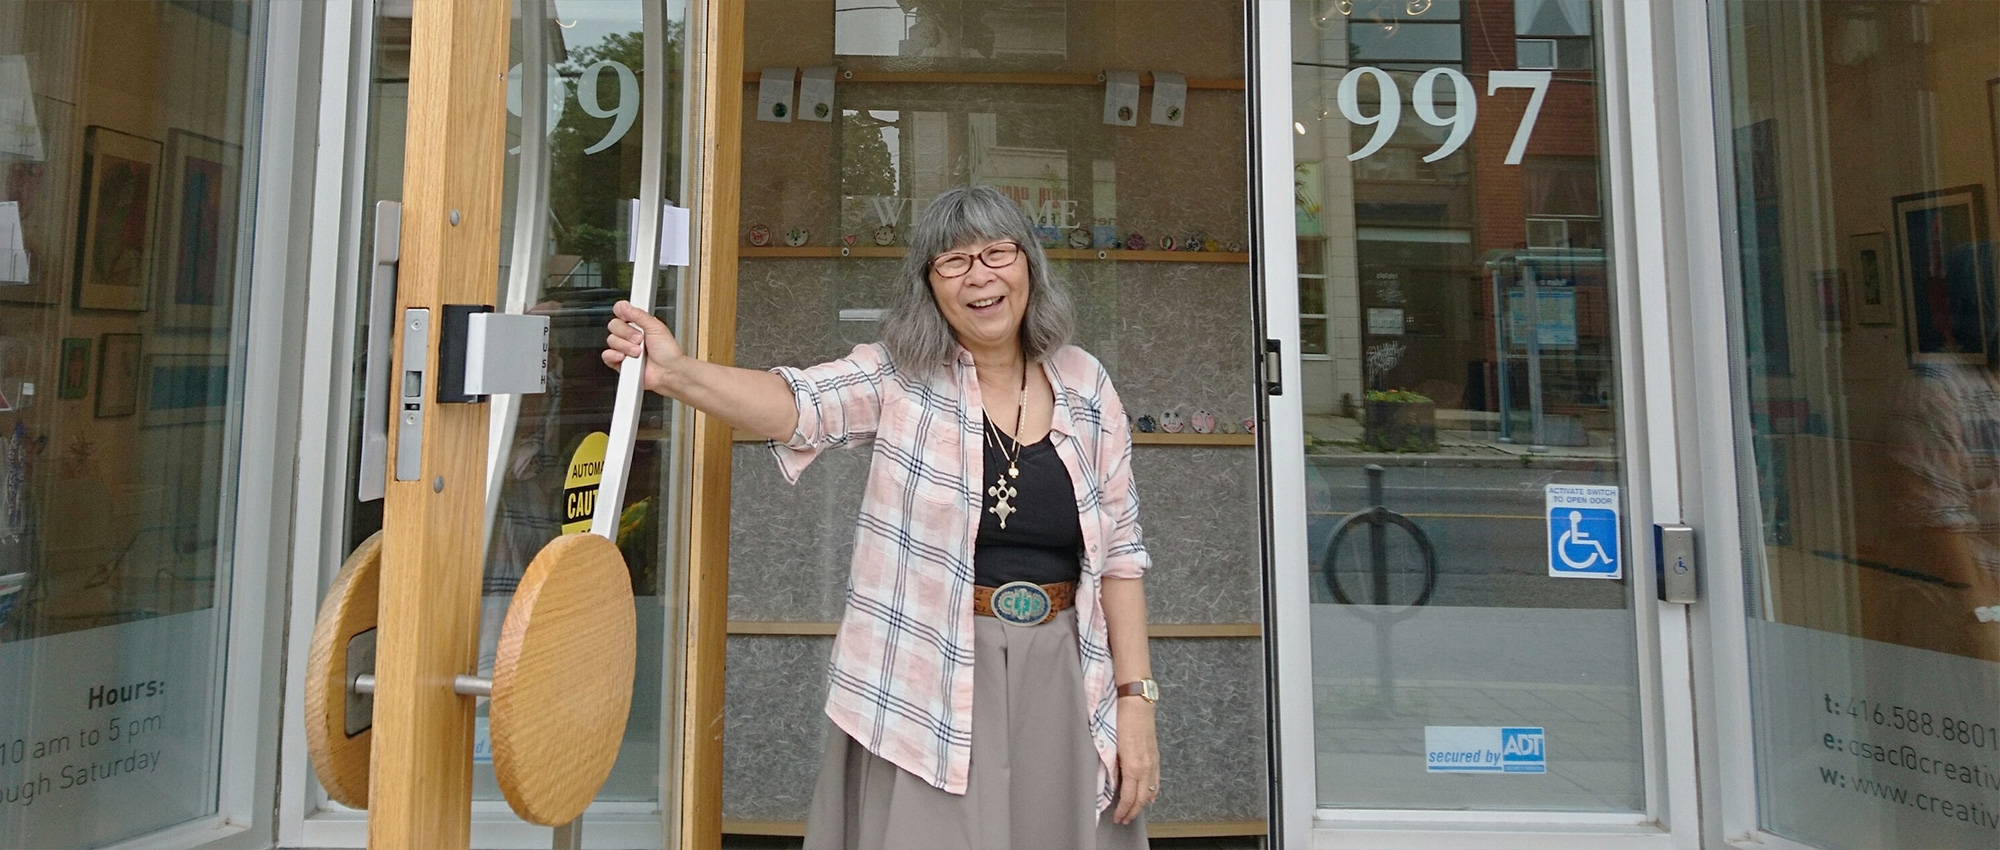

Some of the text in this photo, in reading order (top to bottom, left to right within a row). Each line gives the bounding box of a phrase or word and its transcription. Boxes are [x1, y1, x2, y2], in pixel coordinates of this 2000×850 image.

[1337, 66, 1552, 165] 997
[872, 197, 1081, 229] WEME
[541, 326, 549, 385] PUSH
[1549, 487, 1616, 497] ACTIVATE SWITCH
[88, 680, 165, 710] Hours:
[33, 736, 70, 759] am
[79, 729, 100, 748] to
[109, 717, 121, 741] 5
[128, 715, 162, 743] pm
[1825, 693, 1997, 751] t: 416.588.8801
[1429, 750, 1501, 766] secured by
[1503, 733, 1544, 756] ADT
[1823, 732, 1843, 752] e:
[60, 749, 161, 789] Saturday
[1819, 767, 2000, 830] w: www.creativ
